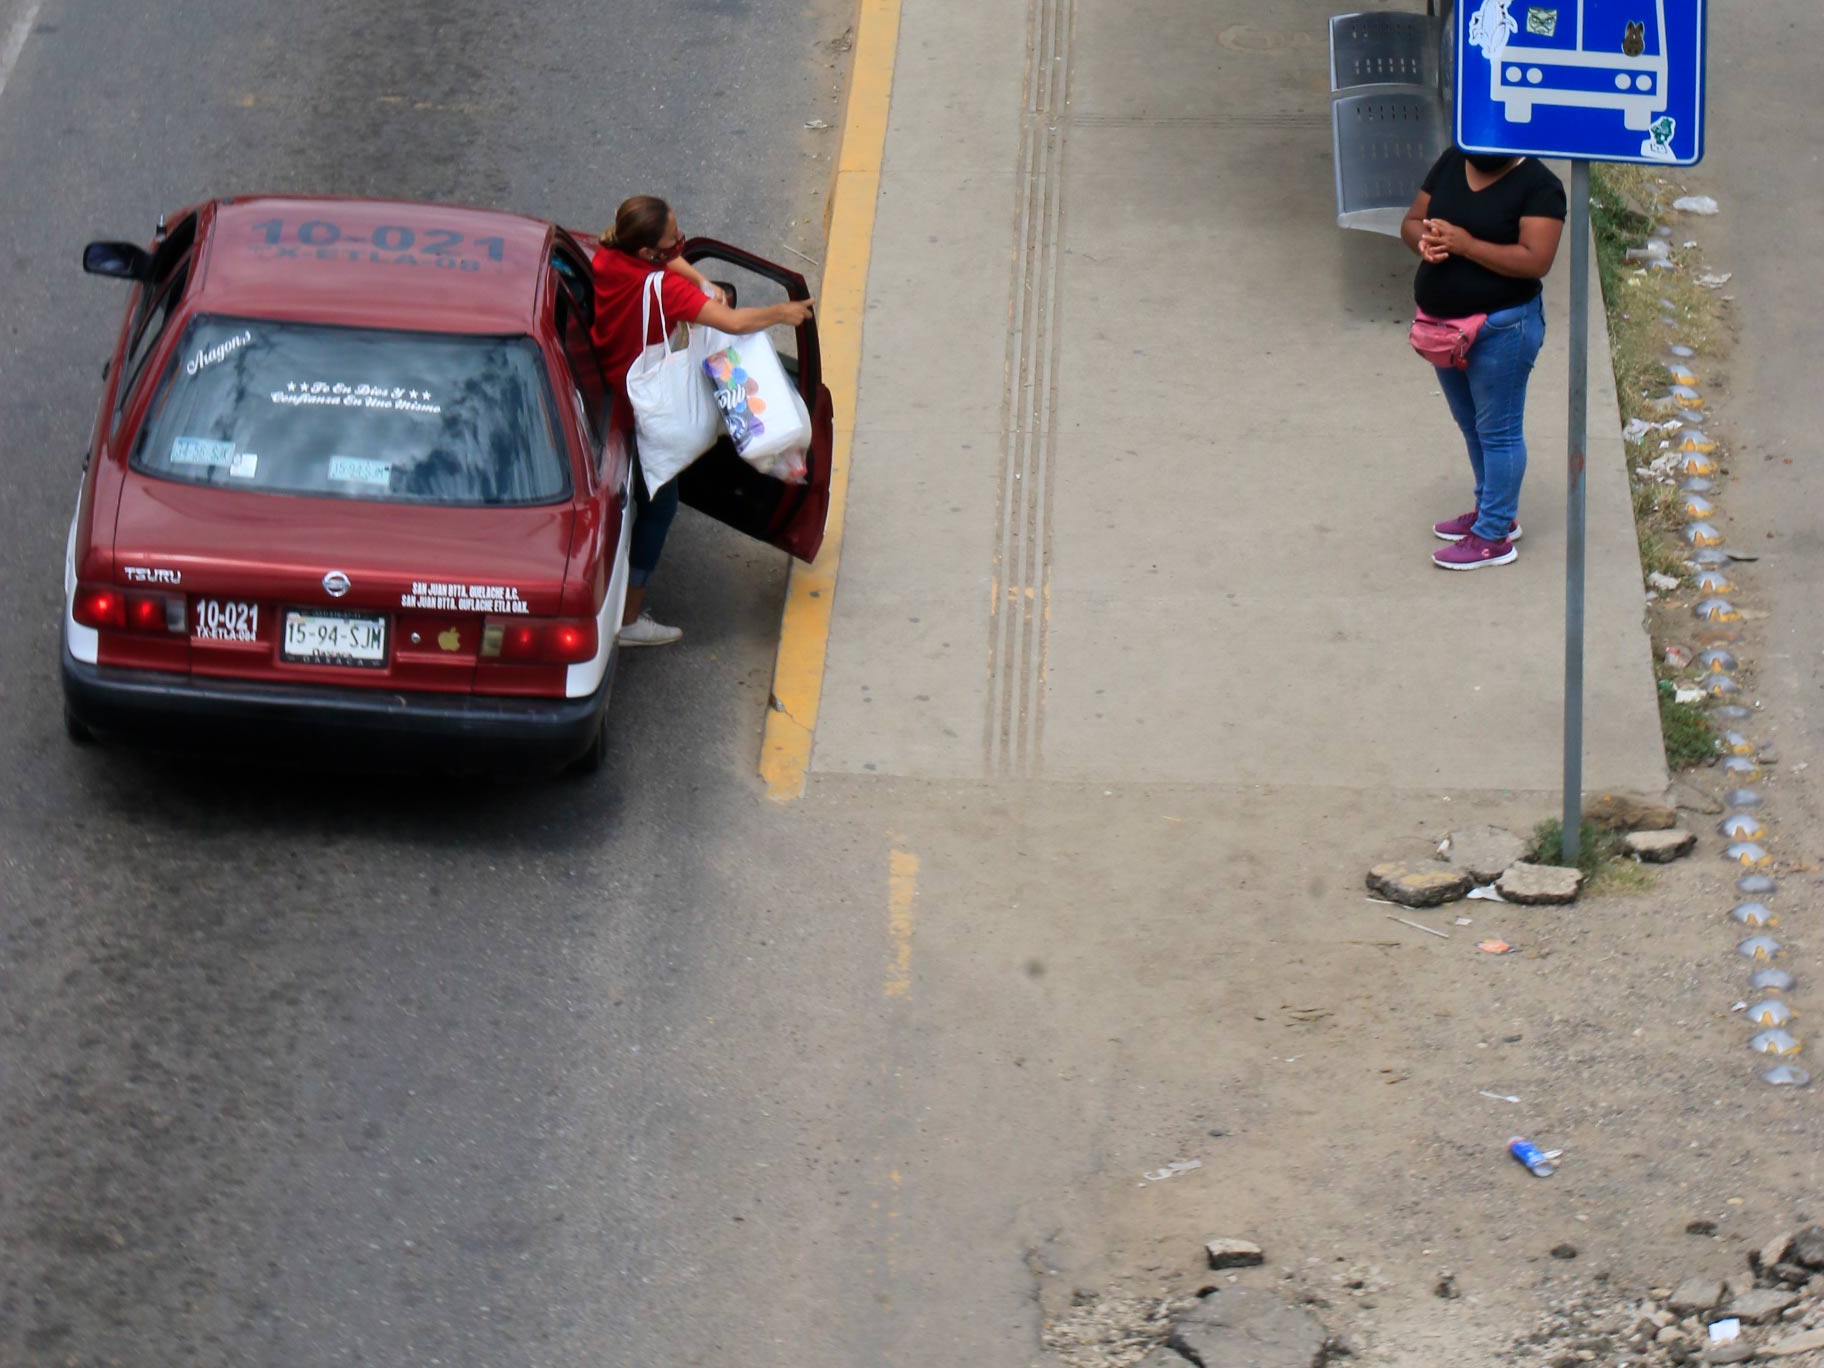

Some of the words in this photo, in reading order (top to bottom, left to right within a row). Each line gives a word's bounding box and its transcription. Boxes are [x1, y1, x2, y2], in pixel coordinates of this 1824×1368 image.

[252, 218, 504, 261] 10-021
[124, 566, 182, 584] TSURU
[412, 581, 427, 595] SAN
[428, 582, 447, 596] JUAN
[401, 594, 416, 607] SAN
[417, 595, 436, 608] JUAN
[197, 599, 258, 632] 10-021
[288, 623, 381, 650] 15-94-SJM
